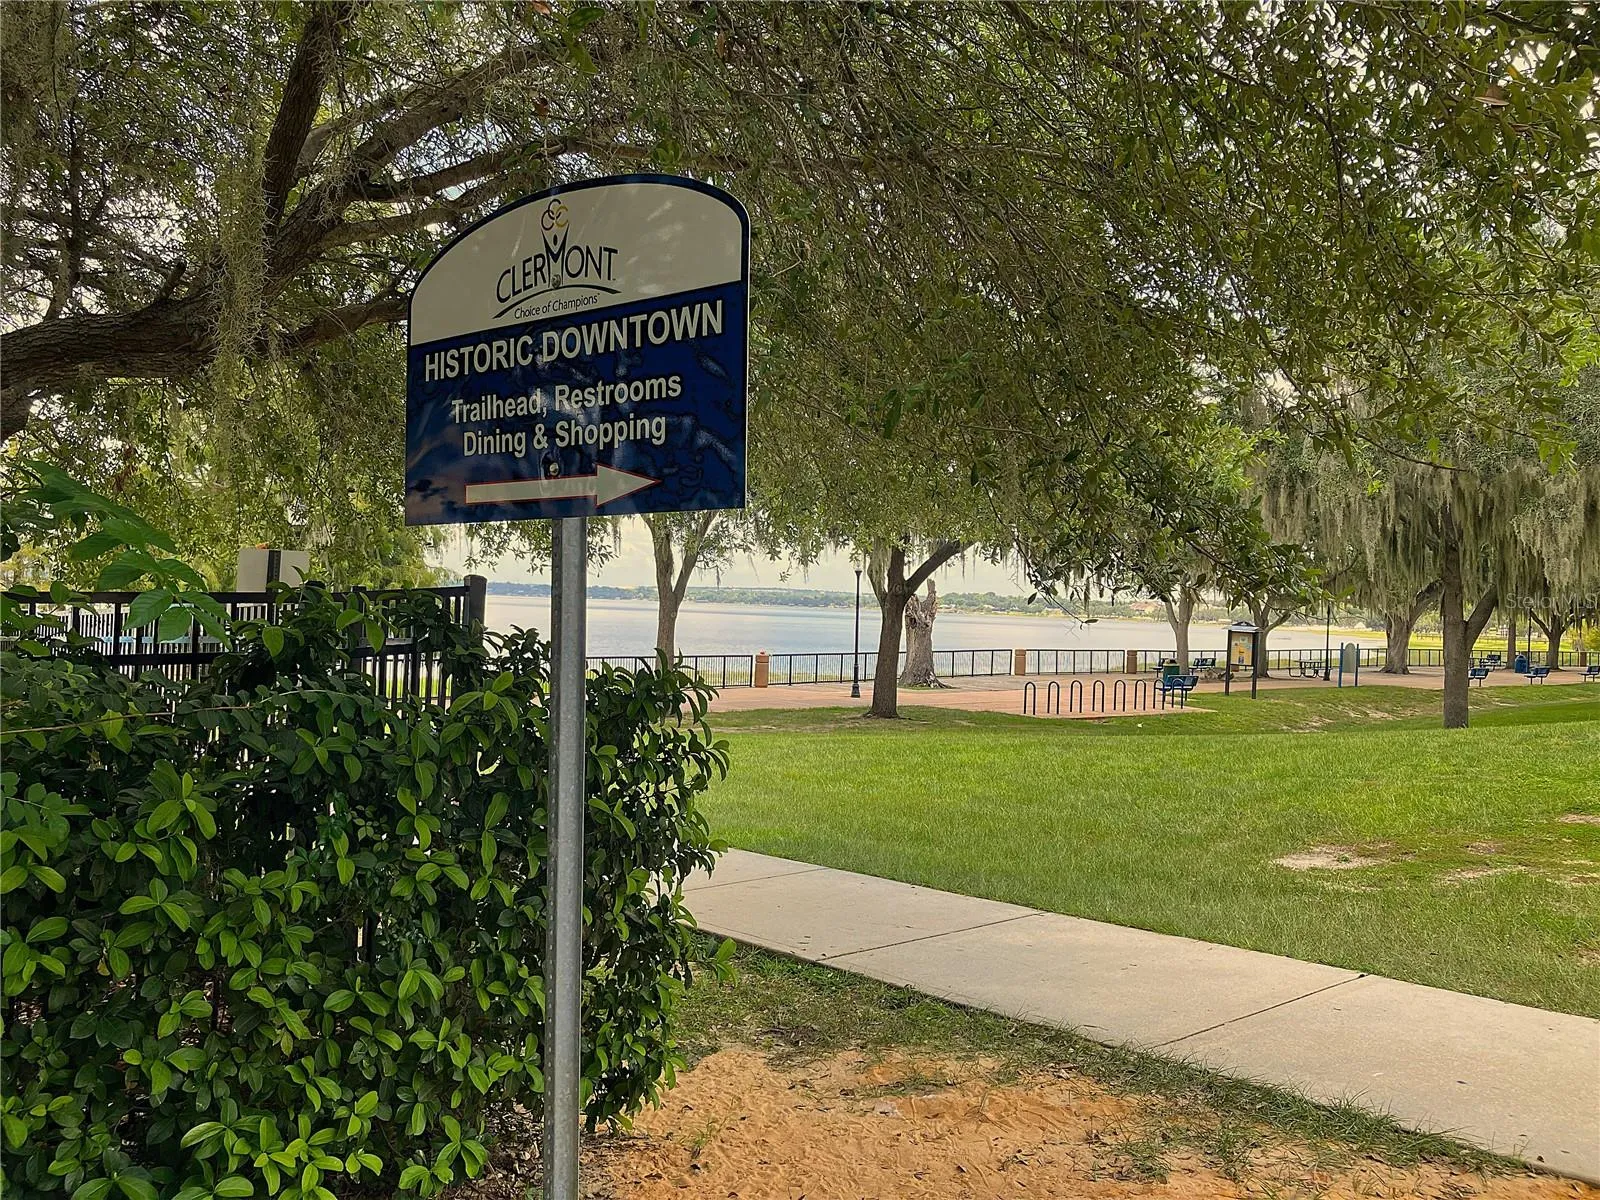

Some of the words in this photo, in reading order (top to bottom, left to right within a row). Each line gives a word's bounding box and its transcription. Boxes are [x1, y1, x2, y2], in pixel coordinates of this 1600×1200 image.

[496, 224, 619, 304] CLERMONT
[514, 305, 541, 319] Choice
[541, 300, 552, 314] of
[552, 294, 598, 312] Champions
[425, 335, 533, 382] HISTORIC
[542, 300, 722, 363] DOWNTOWN
[452, 388, 547, 423] Trailhead,
[555, 375, 682, 411] Restrooms
[463, 429, 526, 458] Dining
[533, 423, 549, 450] &
[555, 412, 666, 450] Shopping
